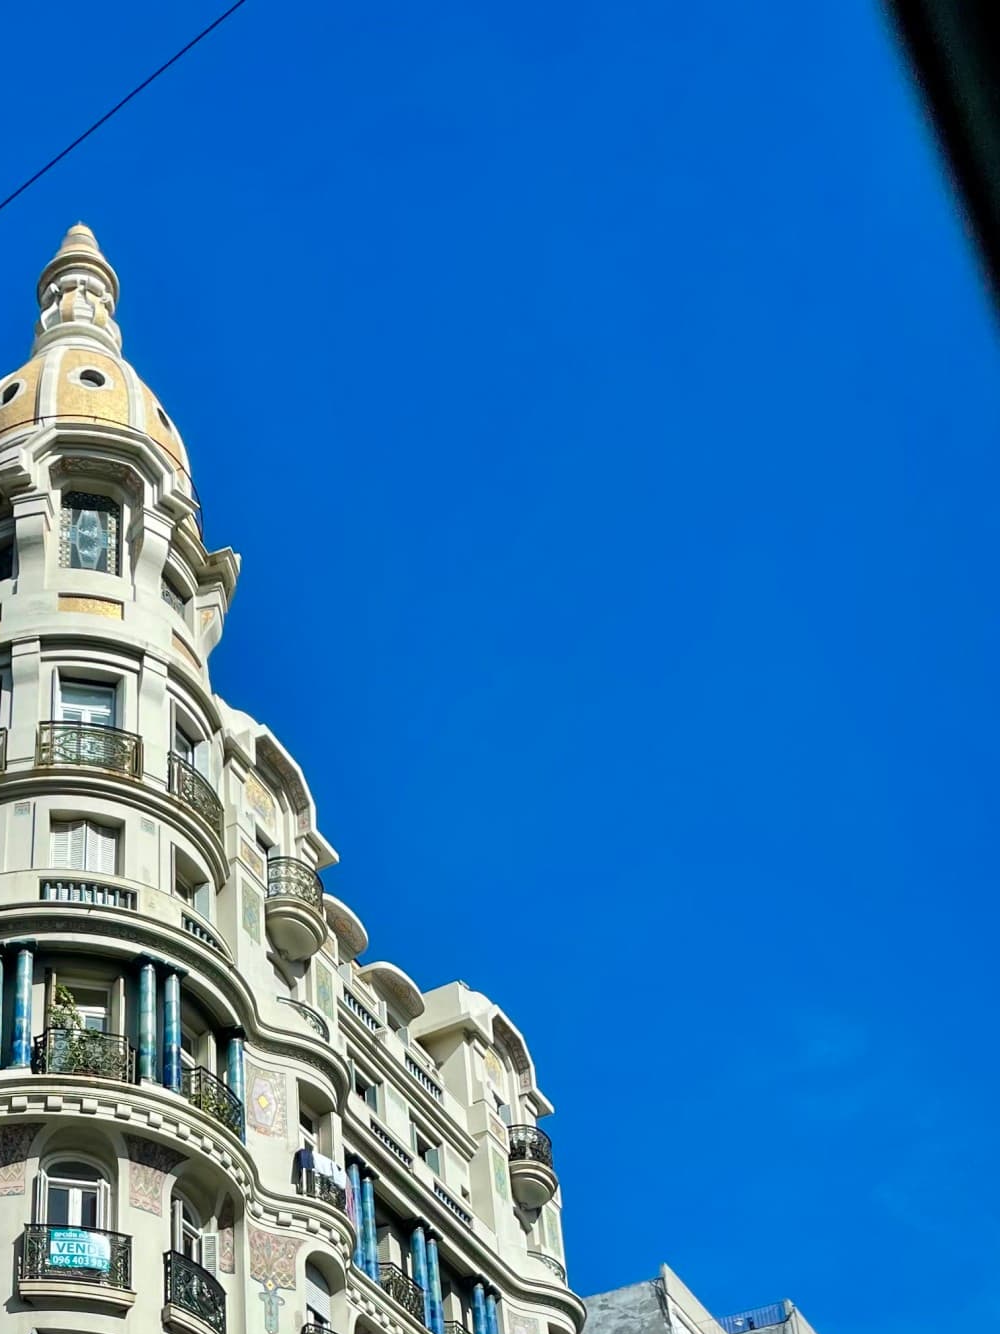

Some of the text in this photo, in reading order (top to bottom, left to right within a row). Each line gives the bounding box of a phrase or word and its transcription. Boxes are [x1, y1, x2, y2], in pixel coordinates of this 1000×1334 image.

[56, 1242, 105, 1257] VENDE
[52, 1255, 70, 1264] 096
[72, 1255, 89, 1265] 403
